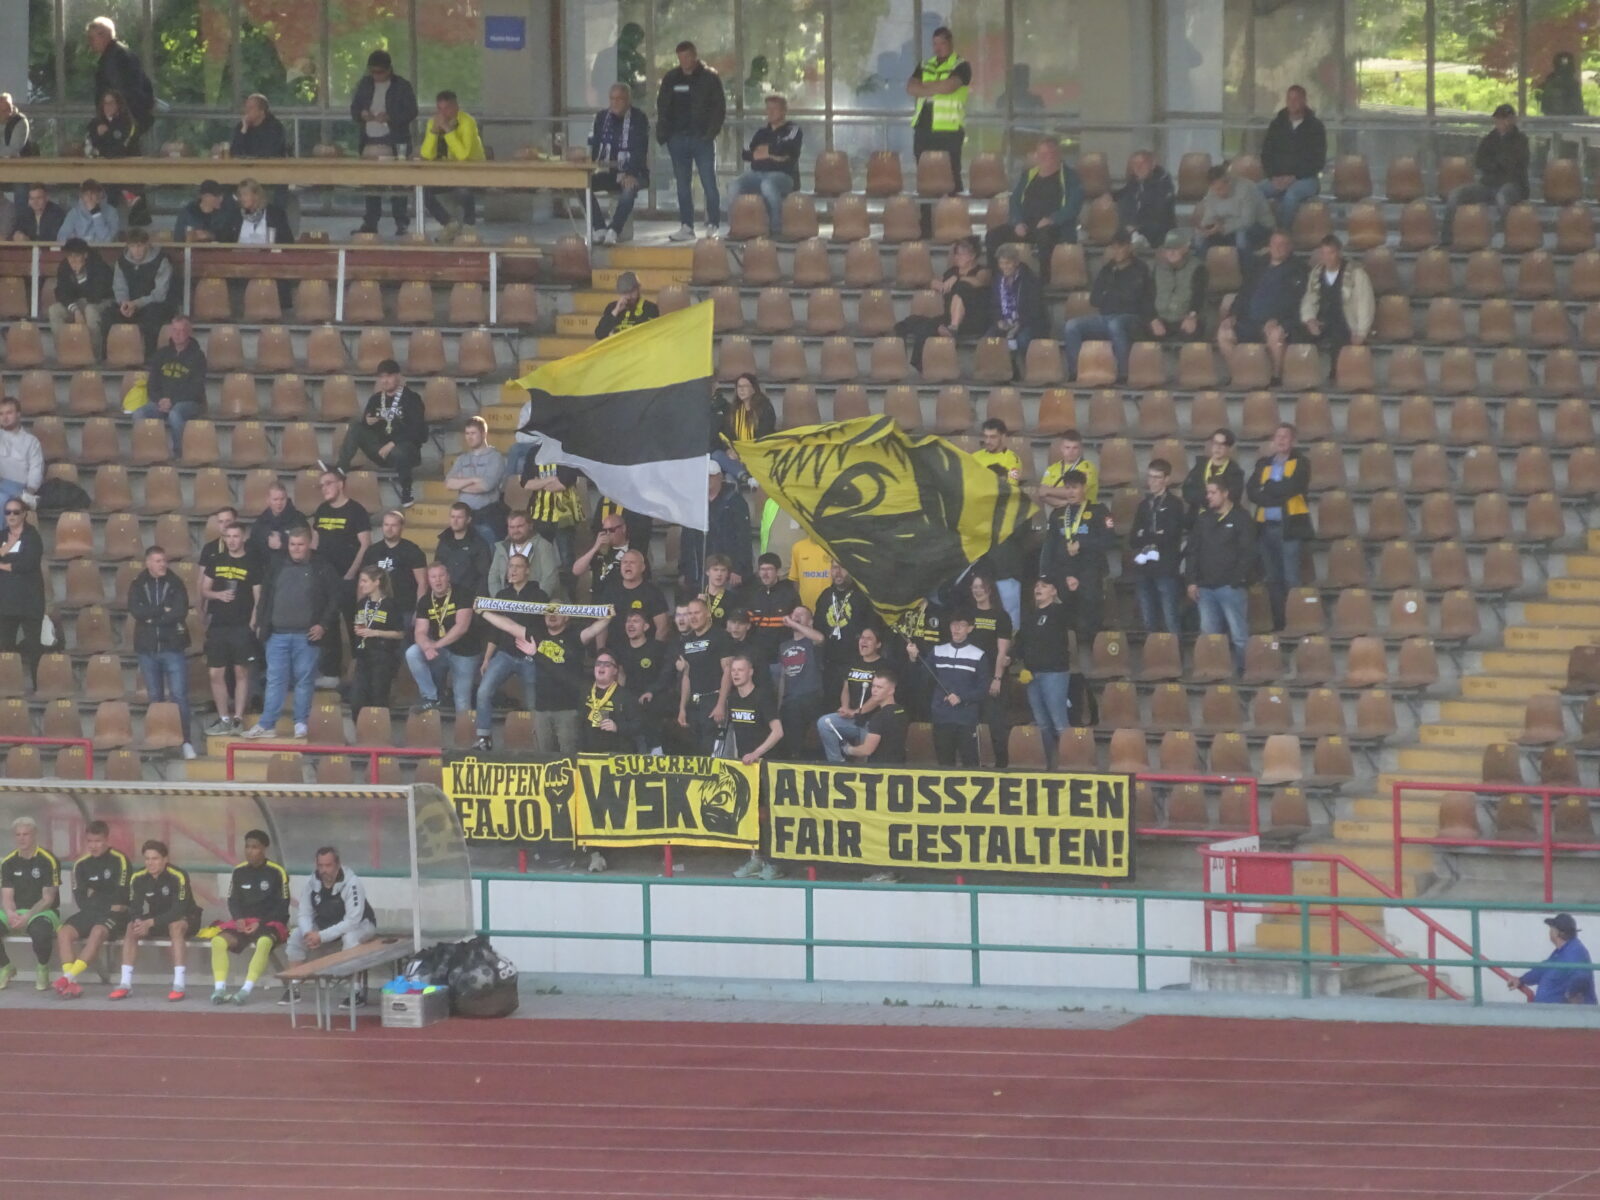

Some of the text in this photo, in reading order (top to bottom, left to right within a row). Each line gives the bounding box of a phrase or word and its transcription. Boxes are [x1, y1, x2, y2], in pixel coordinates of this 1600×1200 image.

[734, 711, 752, 721] WSK
[452, 757, 542, 797] KÄMPFEN
[614, 755, 714, 776] SUPCREW
[580, 764, 700, 830] WSK
[774, 768, 1125, 819] ANSTOSSZEITEN
[453, 797, 544, 839] FAJO
[775, 816, 1125, 868] FAIR GESTALTEN!
